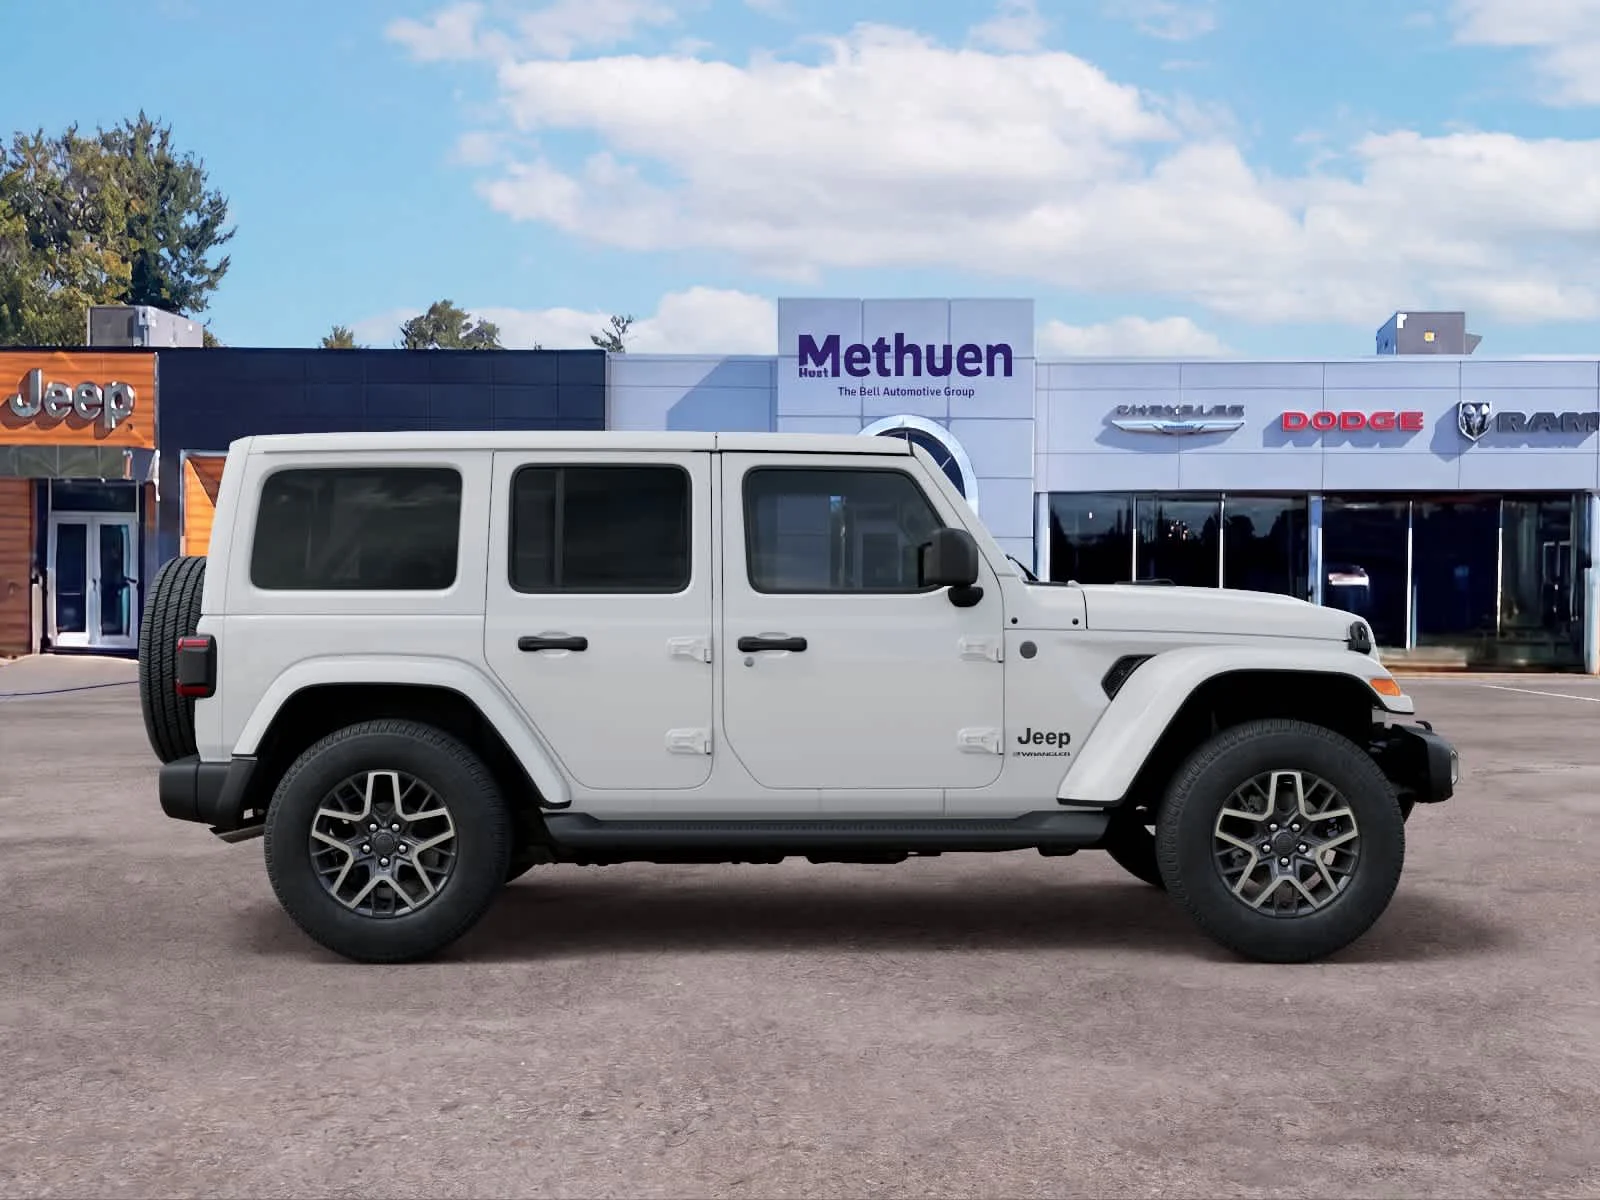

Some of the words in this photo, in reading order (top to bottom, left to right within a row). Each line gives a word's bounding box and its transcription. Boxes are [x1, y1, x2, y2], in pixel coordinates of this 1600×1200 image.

[798, 333, 1013, 377] Methuen
[9, 368, 136, 429] Jeep
[838, 386, 857, 397] The
[859, 386, 880, 397] Bell
[883, 386, 941, 397] Automotive
[943, 386, 975, 399] Group
[1282, 411, 1423, 432] DODGE
[1497, 412, 1600, 432] RAM
[1017, 727, 1071, 749] Jeep
